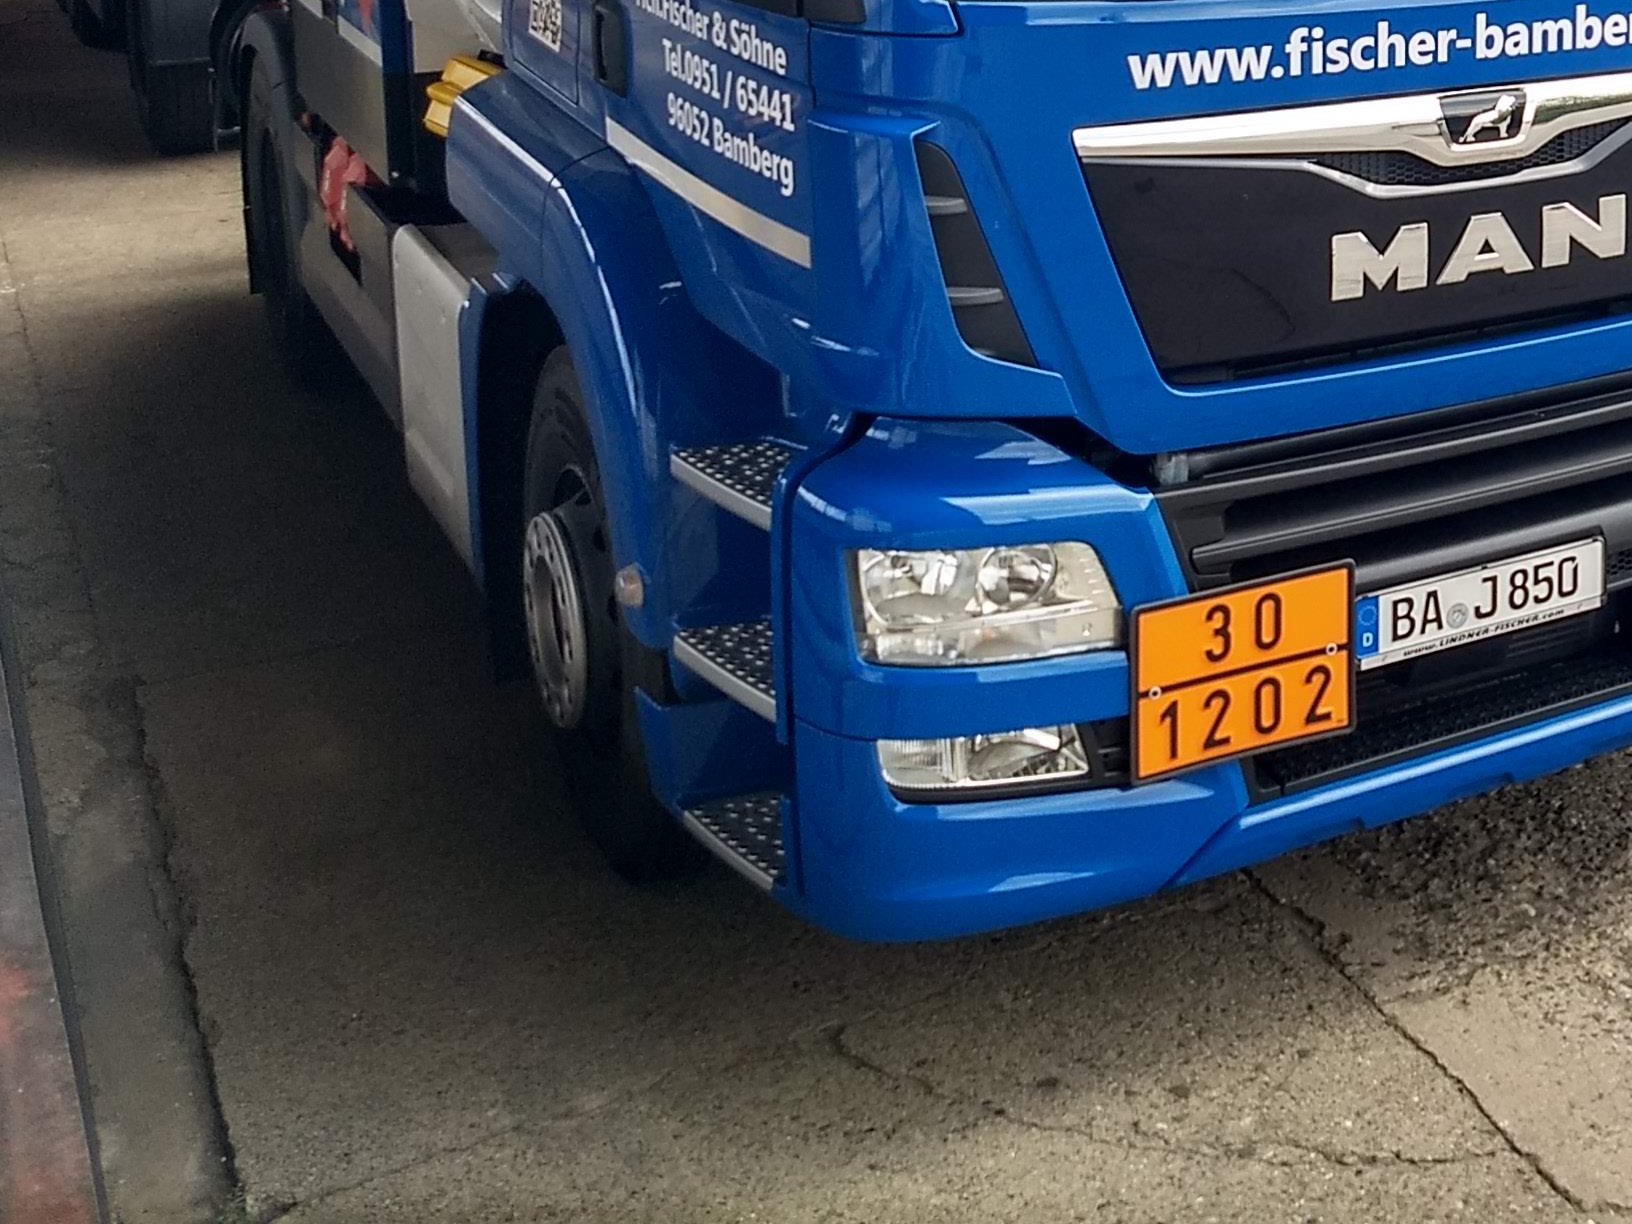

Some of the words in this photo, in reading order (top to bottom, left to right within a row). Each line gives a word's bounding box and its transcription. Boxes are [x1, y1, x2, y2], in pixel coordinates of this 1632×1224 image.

[662, 37, 721, 101] Tel.0951
[723, 70, 733, 109] /
[735, 76, 796, 133] 65441
[712, 11, 728, 51] &
[730, 18, 787, 76] Söhne
[666, 92, 711, 147] 96052
[712, 117, 795, 197] Bamberg
[1330, 192, 1627, 302] MAN
[1204, 592, 1283, 663] 30
[1362, 632, 1373, 647] D
[1391, 588, 1444, 643] BA
[1158, 664, 1333, 760] 1202
